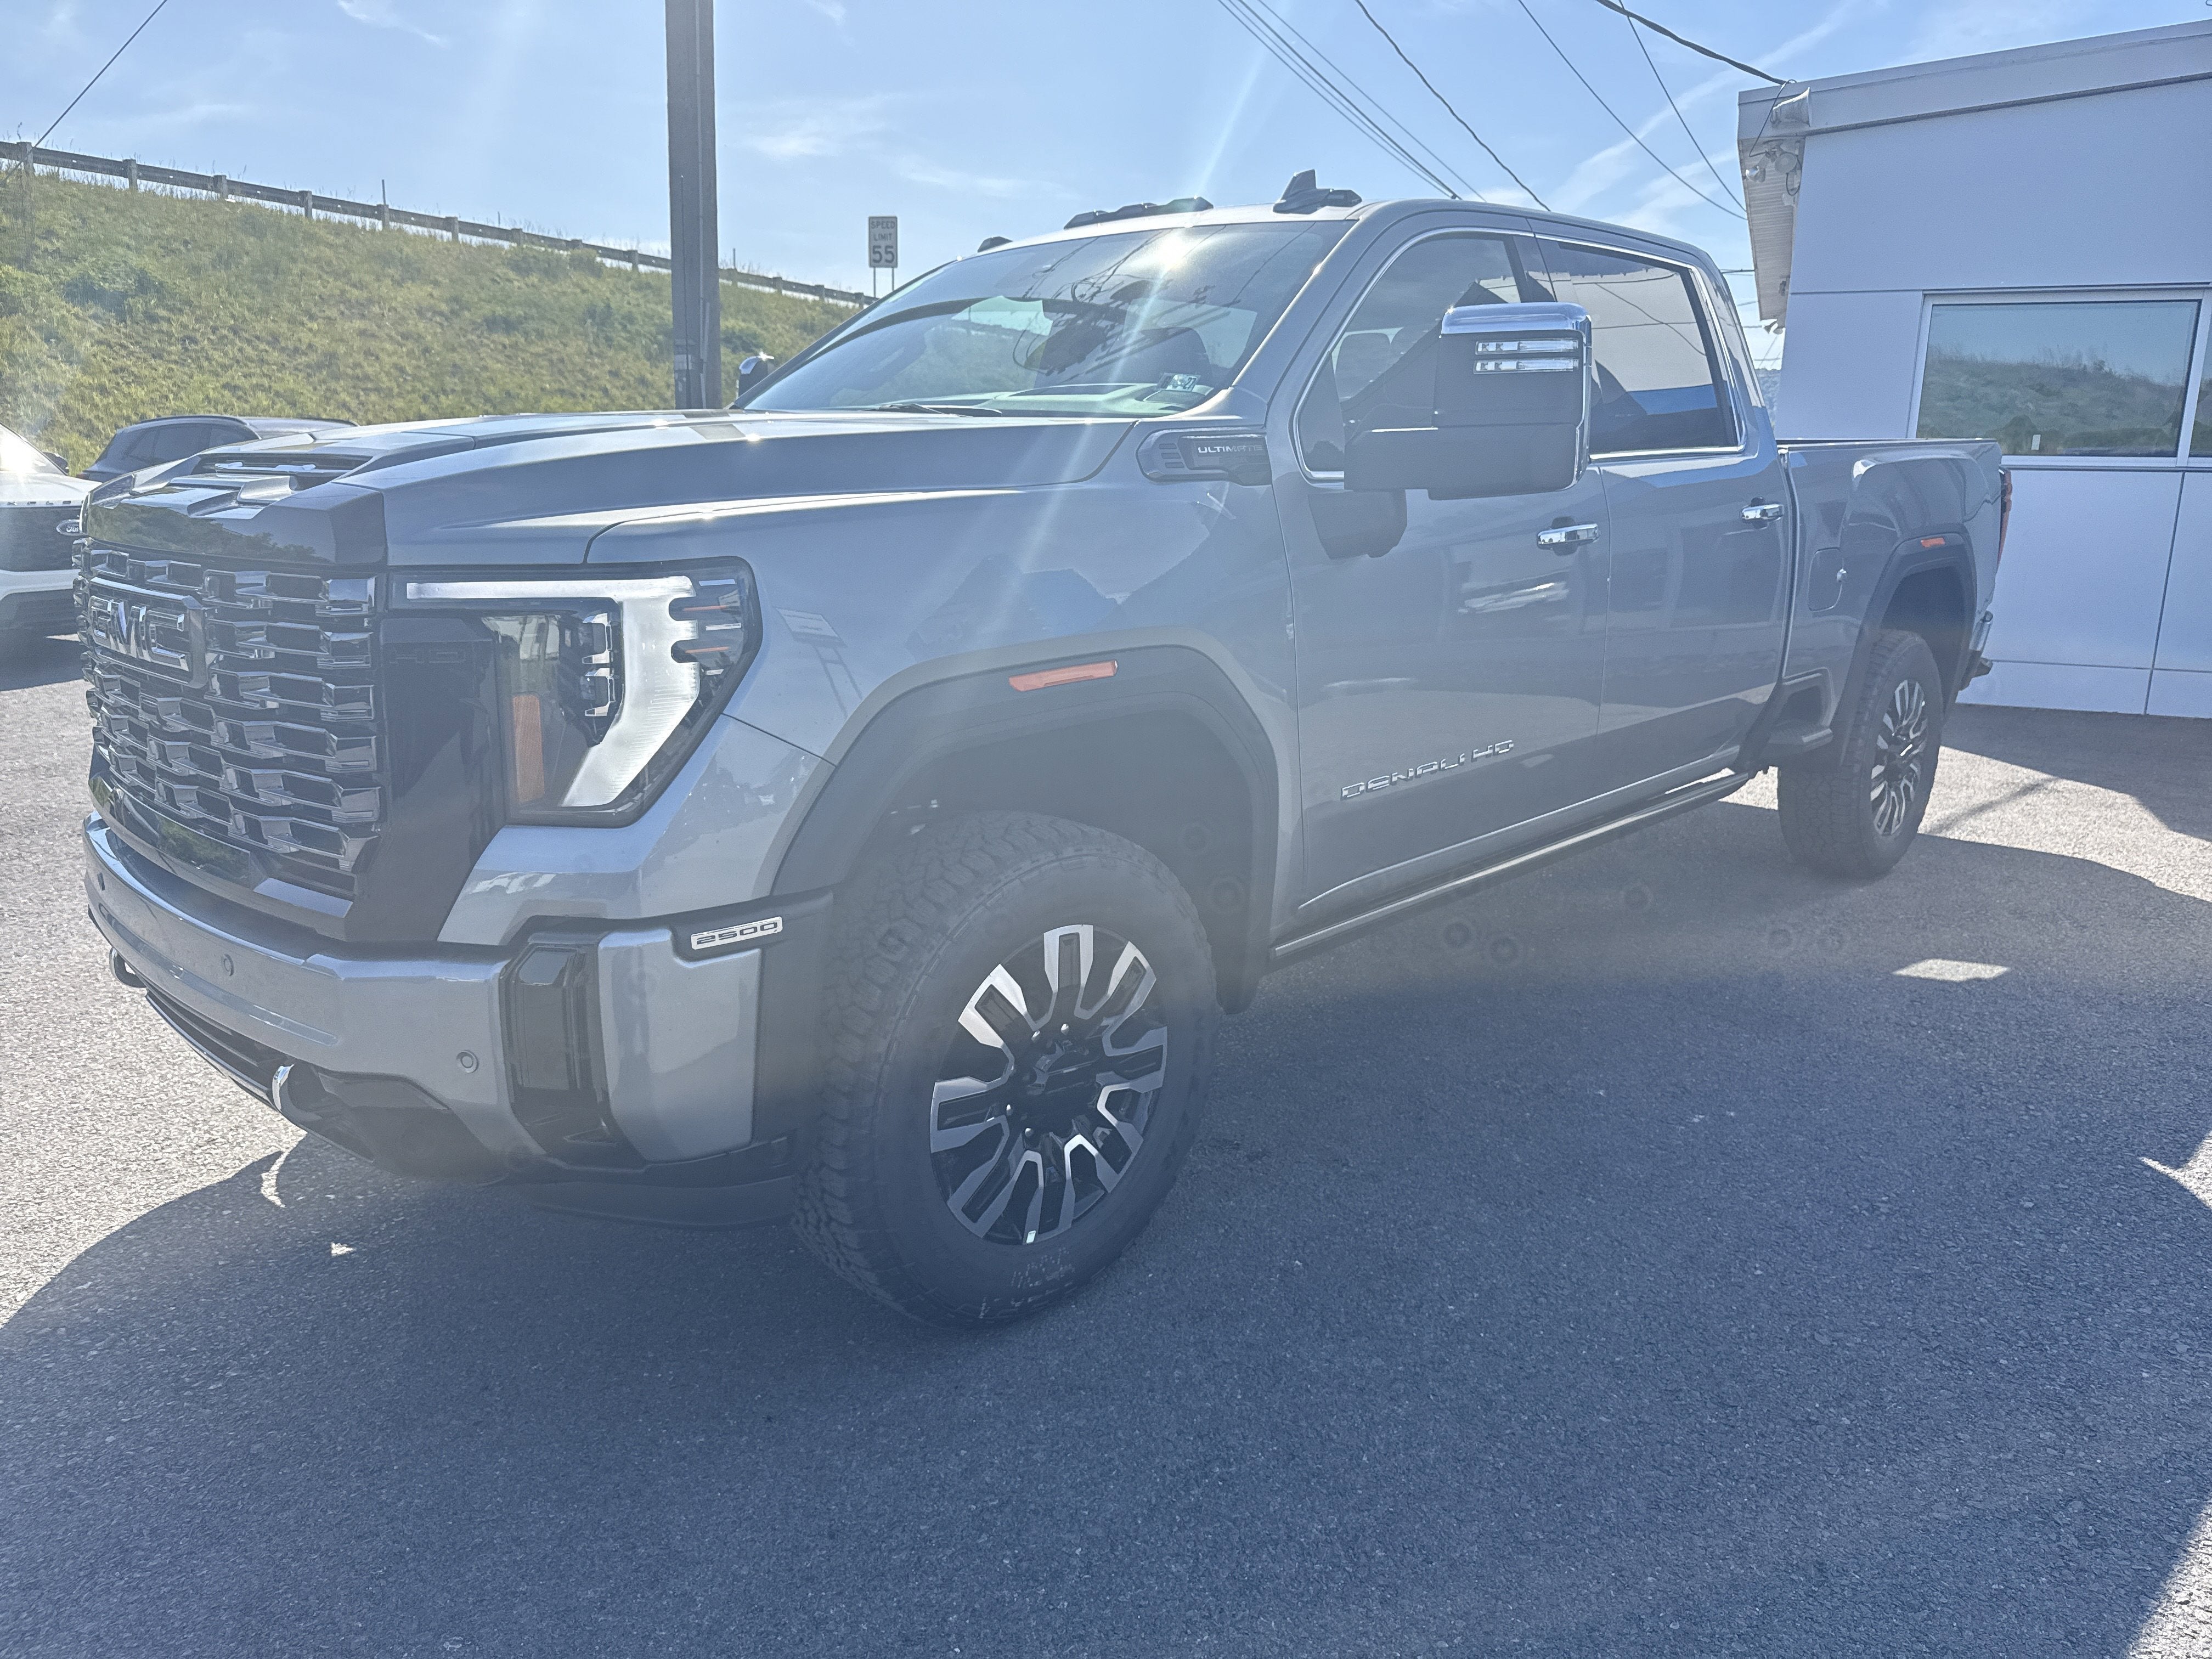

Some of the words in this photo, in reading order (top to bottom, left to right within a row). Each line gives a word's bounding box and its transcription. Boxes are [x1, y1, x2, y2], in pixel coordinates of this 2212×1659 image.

[873, 233, 893, 241] LIMIT
[872, 245, 895, 263] 55
[1183, 377, 1197, 390] 27
[1198, 444, 1263, 453] ULTIMATE
[88, 595, 189, 672] GMC
[1340, 753, 1465, 799] DENALI
[1471, 740, 1514, 763] HD
[696, 922, 778, 945] 2500
